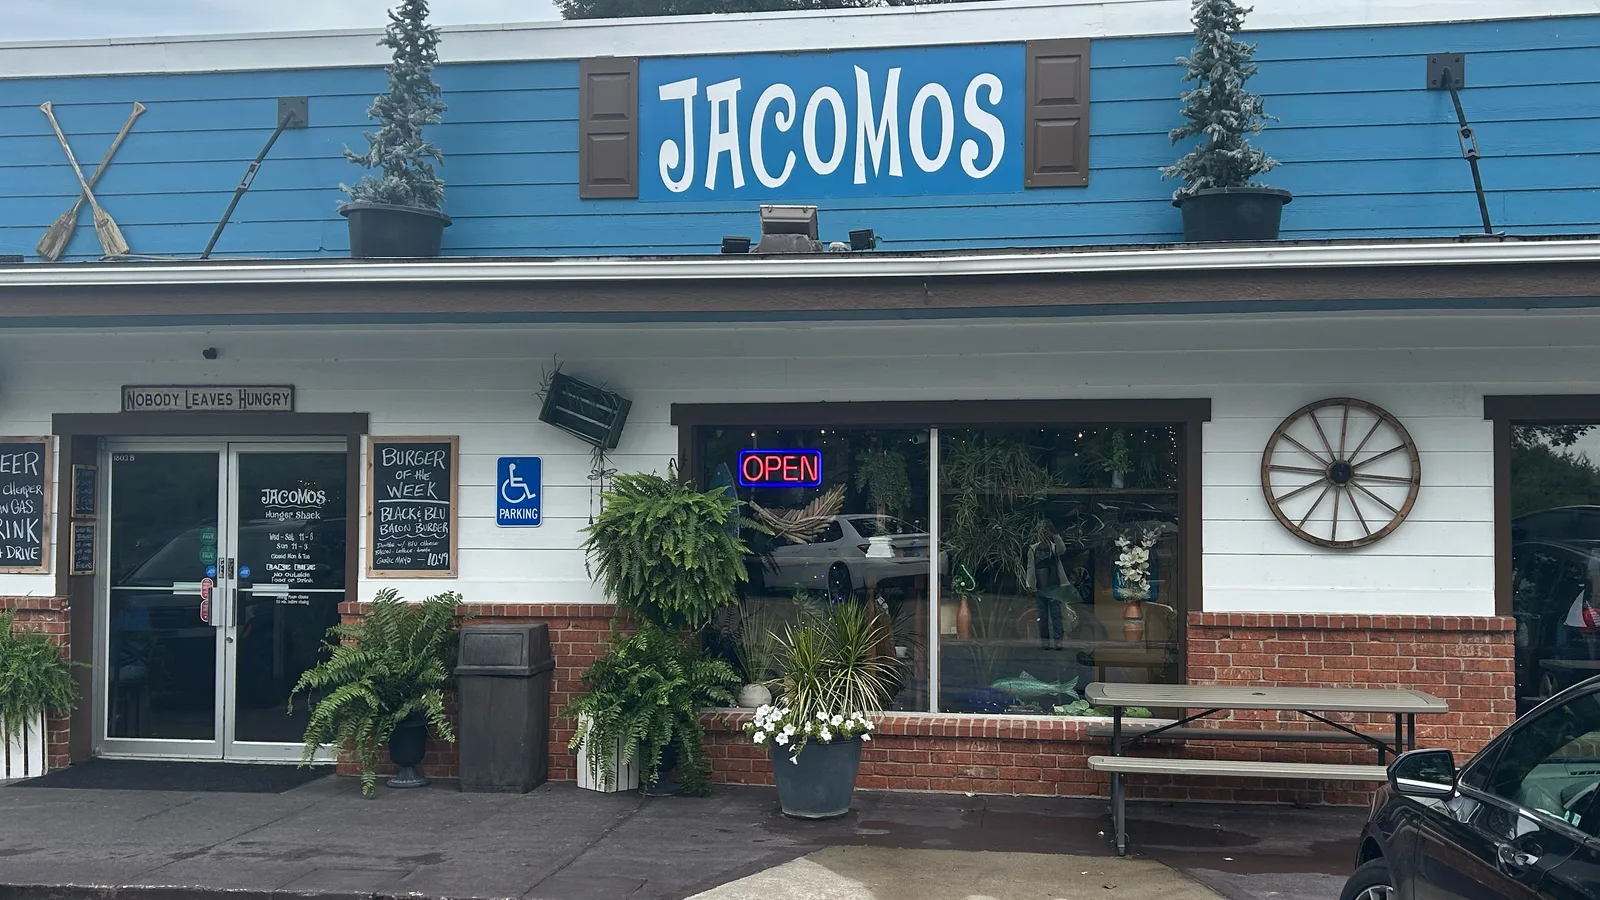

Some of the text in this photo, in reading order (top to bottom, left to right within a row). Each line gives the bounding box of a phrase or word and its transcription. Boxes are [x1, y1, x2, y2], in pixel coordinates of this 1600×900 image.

[659, 64, 1005, 193] JACOMOS
[127, 389, 290, 409] NOBODY LEAVES HUNGRY
[382, 448, 446, 469] BURGER
[395, 470, 411, 480] OF
[742, 455, 819, 482] OPEN
[261, 488, 326, 505] JACOMOS
[386, 482, 438, 499] WEEK
[265, 510, 321, 522] Hunger Shack
[380, 506, 417, 522] BLACK
[424, 506, 446, 520] BLU
[499, 508, 538, 521] PARKING
[379, 522, 448, 535] BACON BURGER
[5, 545, 39, 560] DRIVE
[427, 552, 449, 566] 10.49
